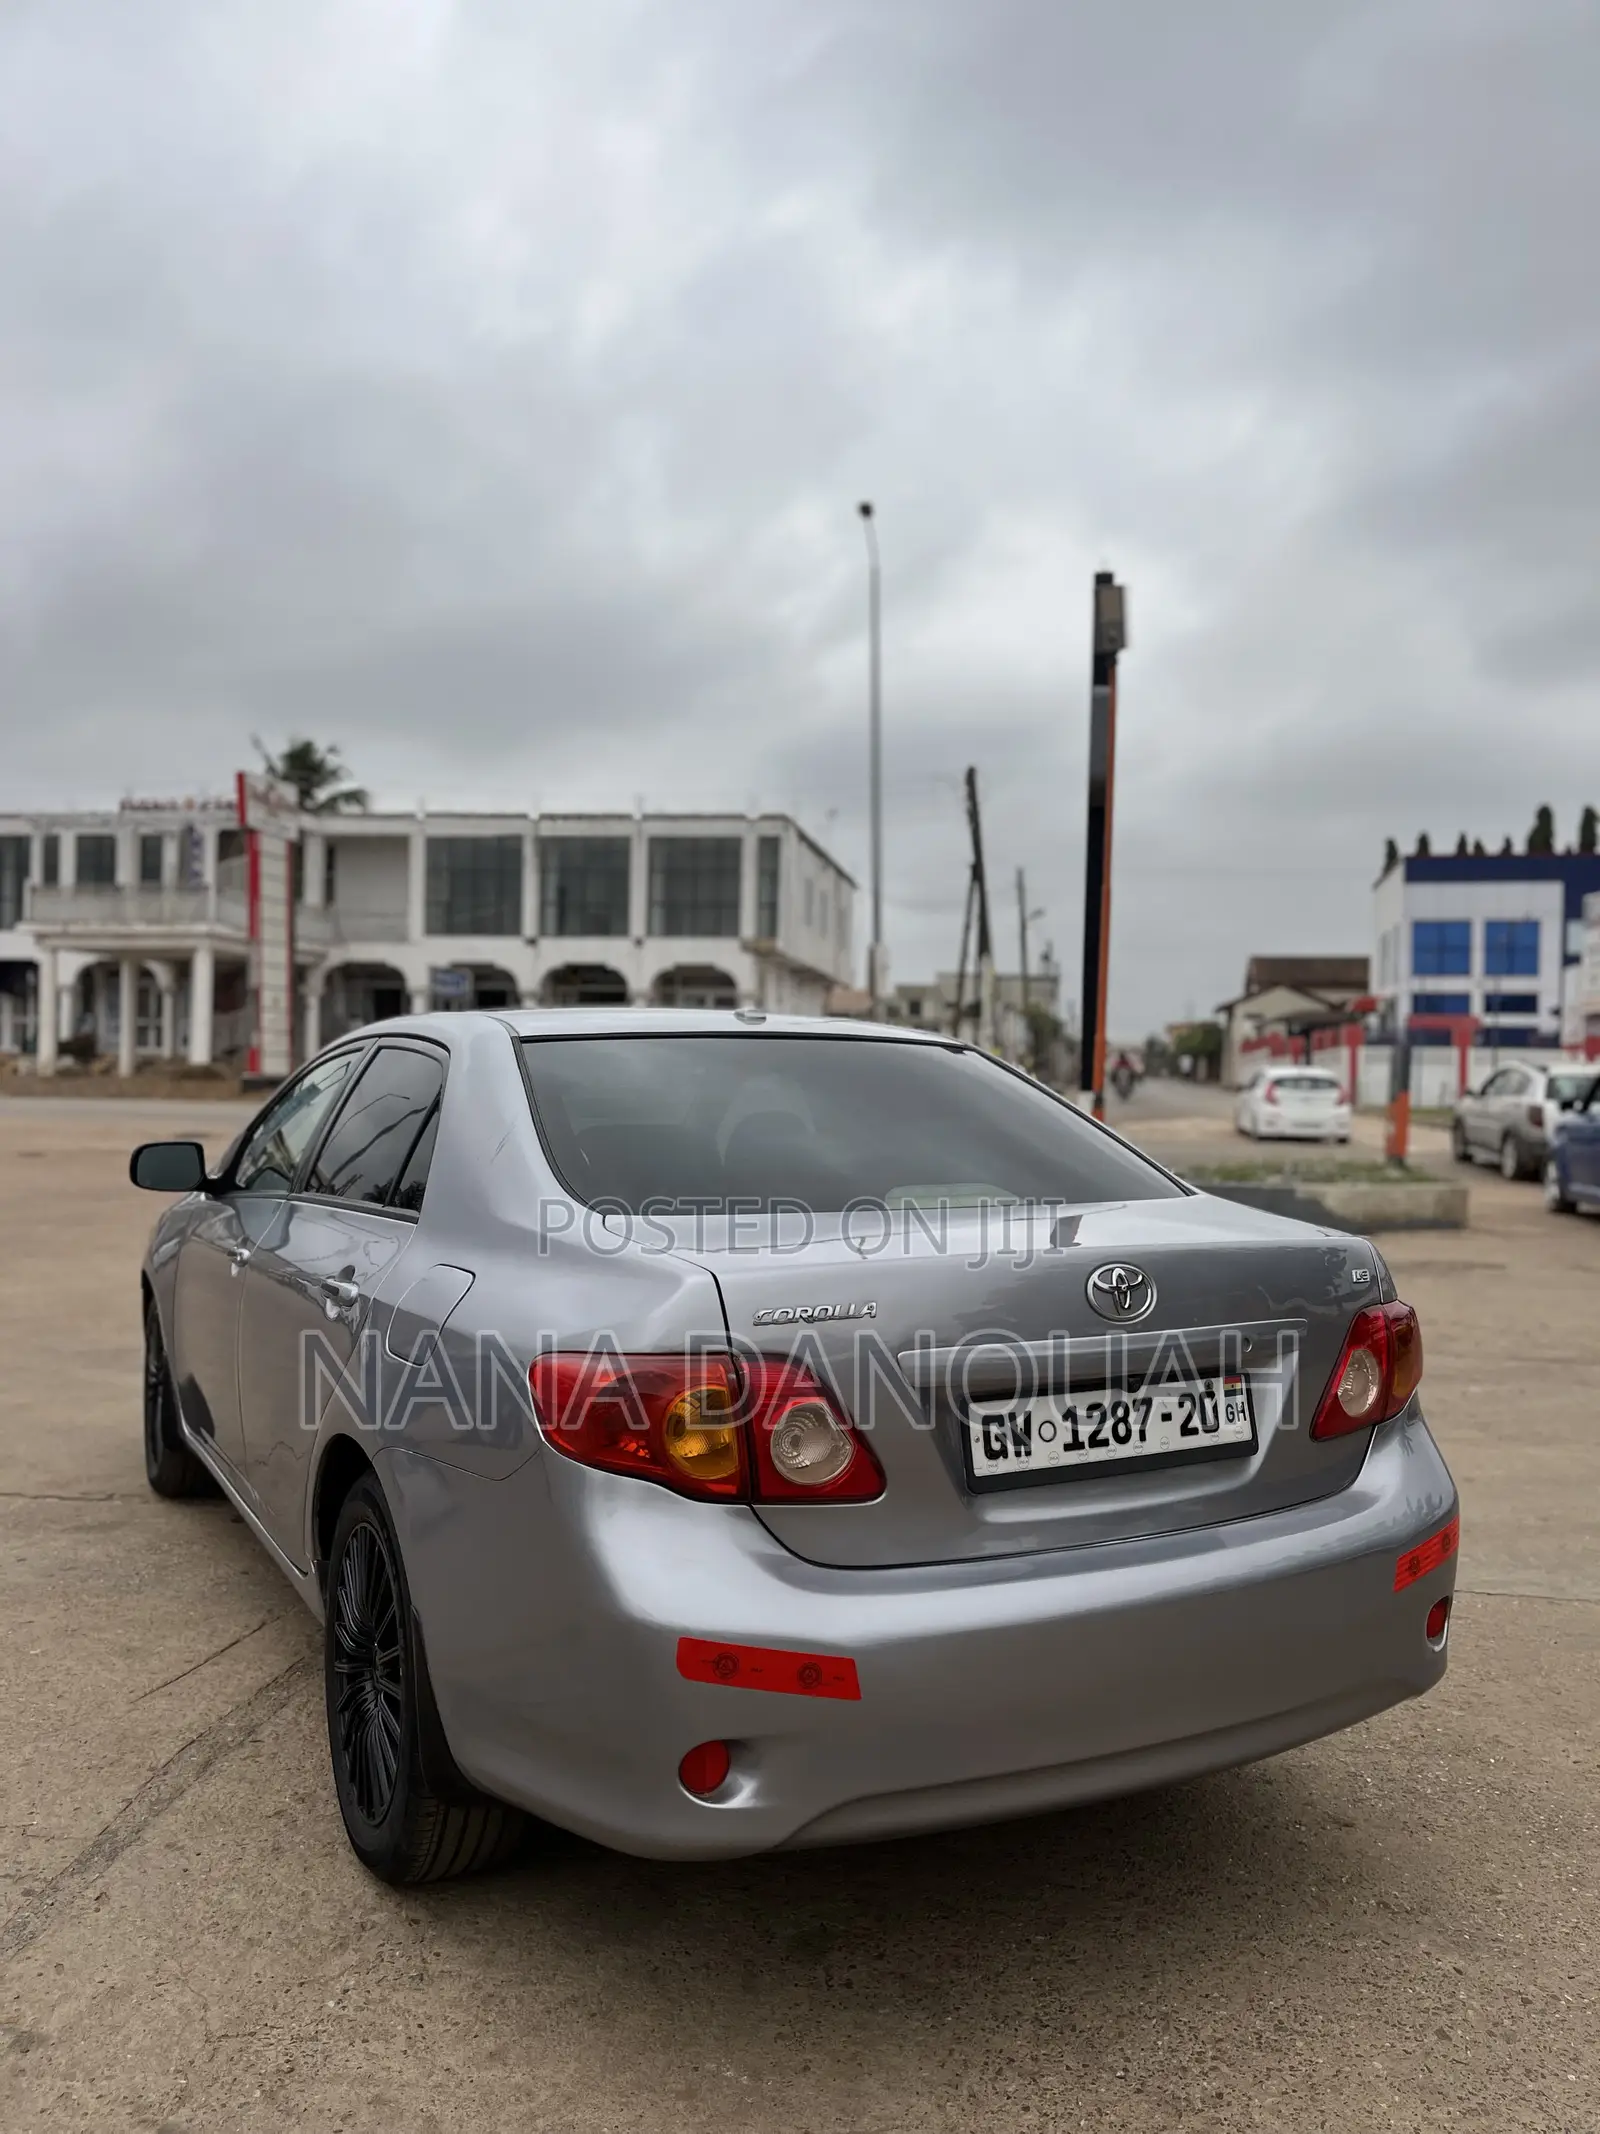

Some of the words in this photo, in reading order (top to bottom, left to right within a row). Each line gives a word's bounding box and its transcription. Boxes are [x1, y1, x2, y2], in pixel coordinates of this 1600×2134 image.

[1351, 1269, 1370, 1284] LE
[753, 1301, 877, 1326] COROLLA
[1225, 1401, 1247, 1424] GH
